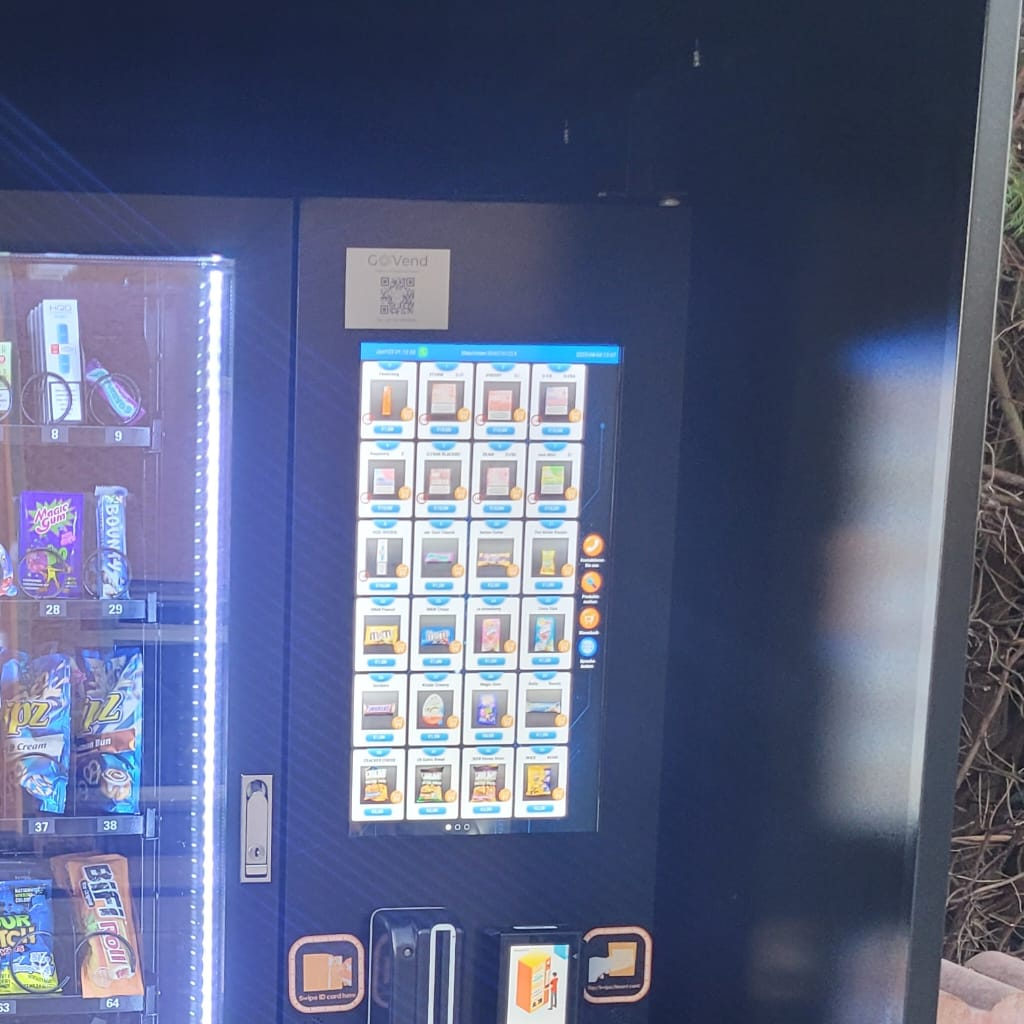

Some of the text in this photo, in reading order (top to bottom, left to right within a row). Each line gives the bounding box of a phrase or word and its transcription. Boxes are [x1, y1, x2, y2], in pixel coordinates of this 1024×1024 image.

[51, 428, 58, 440] 8
[114, 430, 122, 442] 9
[35, 503, 69, 523] Magic
[46, 604, 60, 614] 28
[108, 604, 123, 614] 29
[34, 822, 49, 832] 37
[103, 820, 118, 831] 38
[106, 998, 120, 1008] 64
[298, 994, 318, 1002] Swipe
